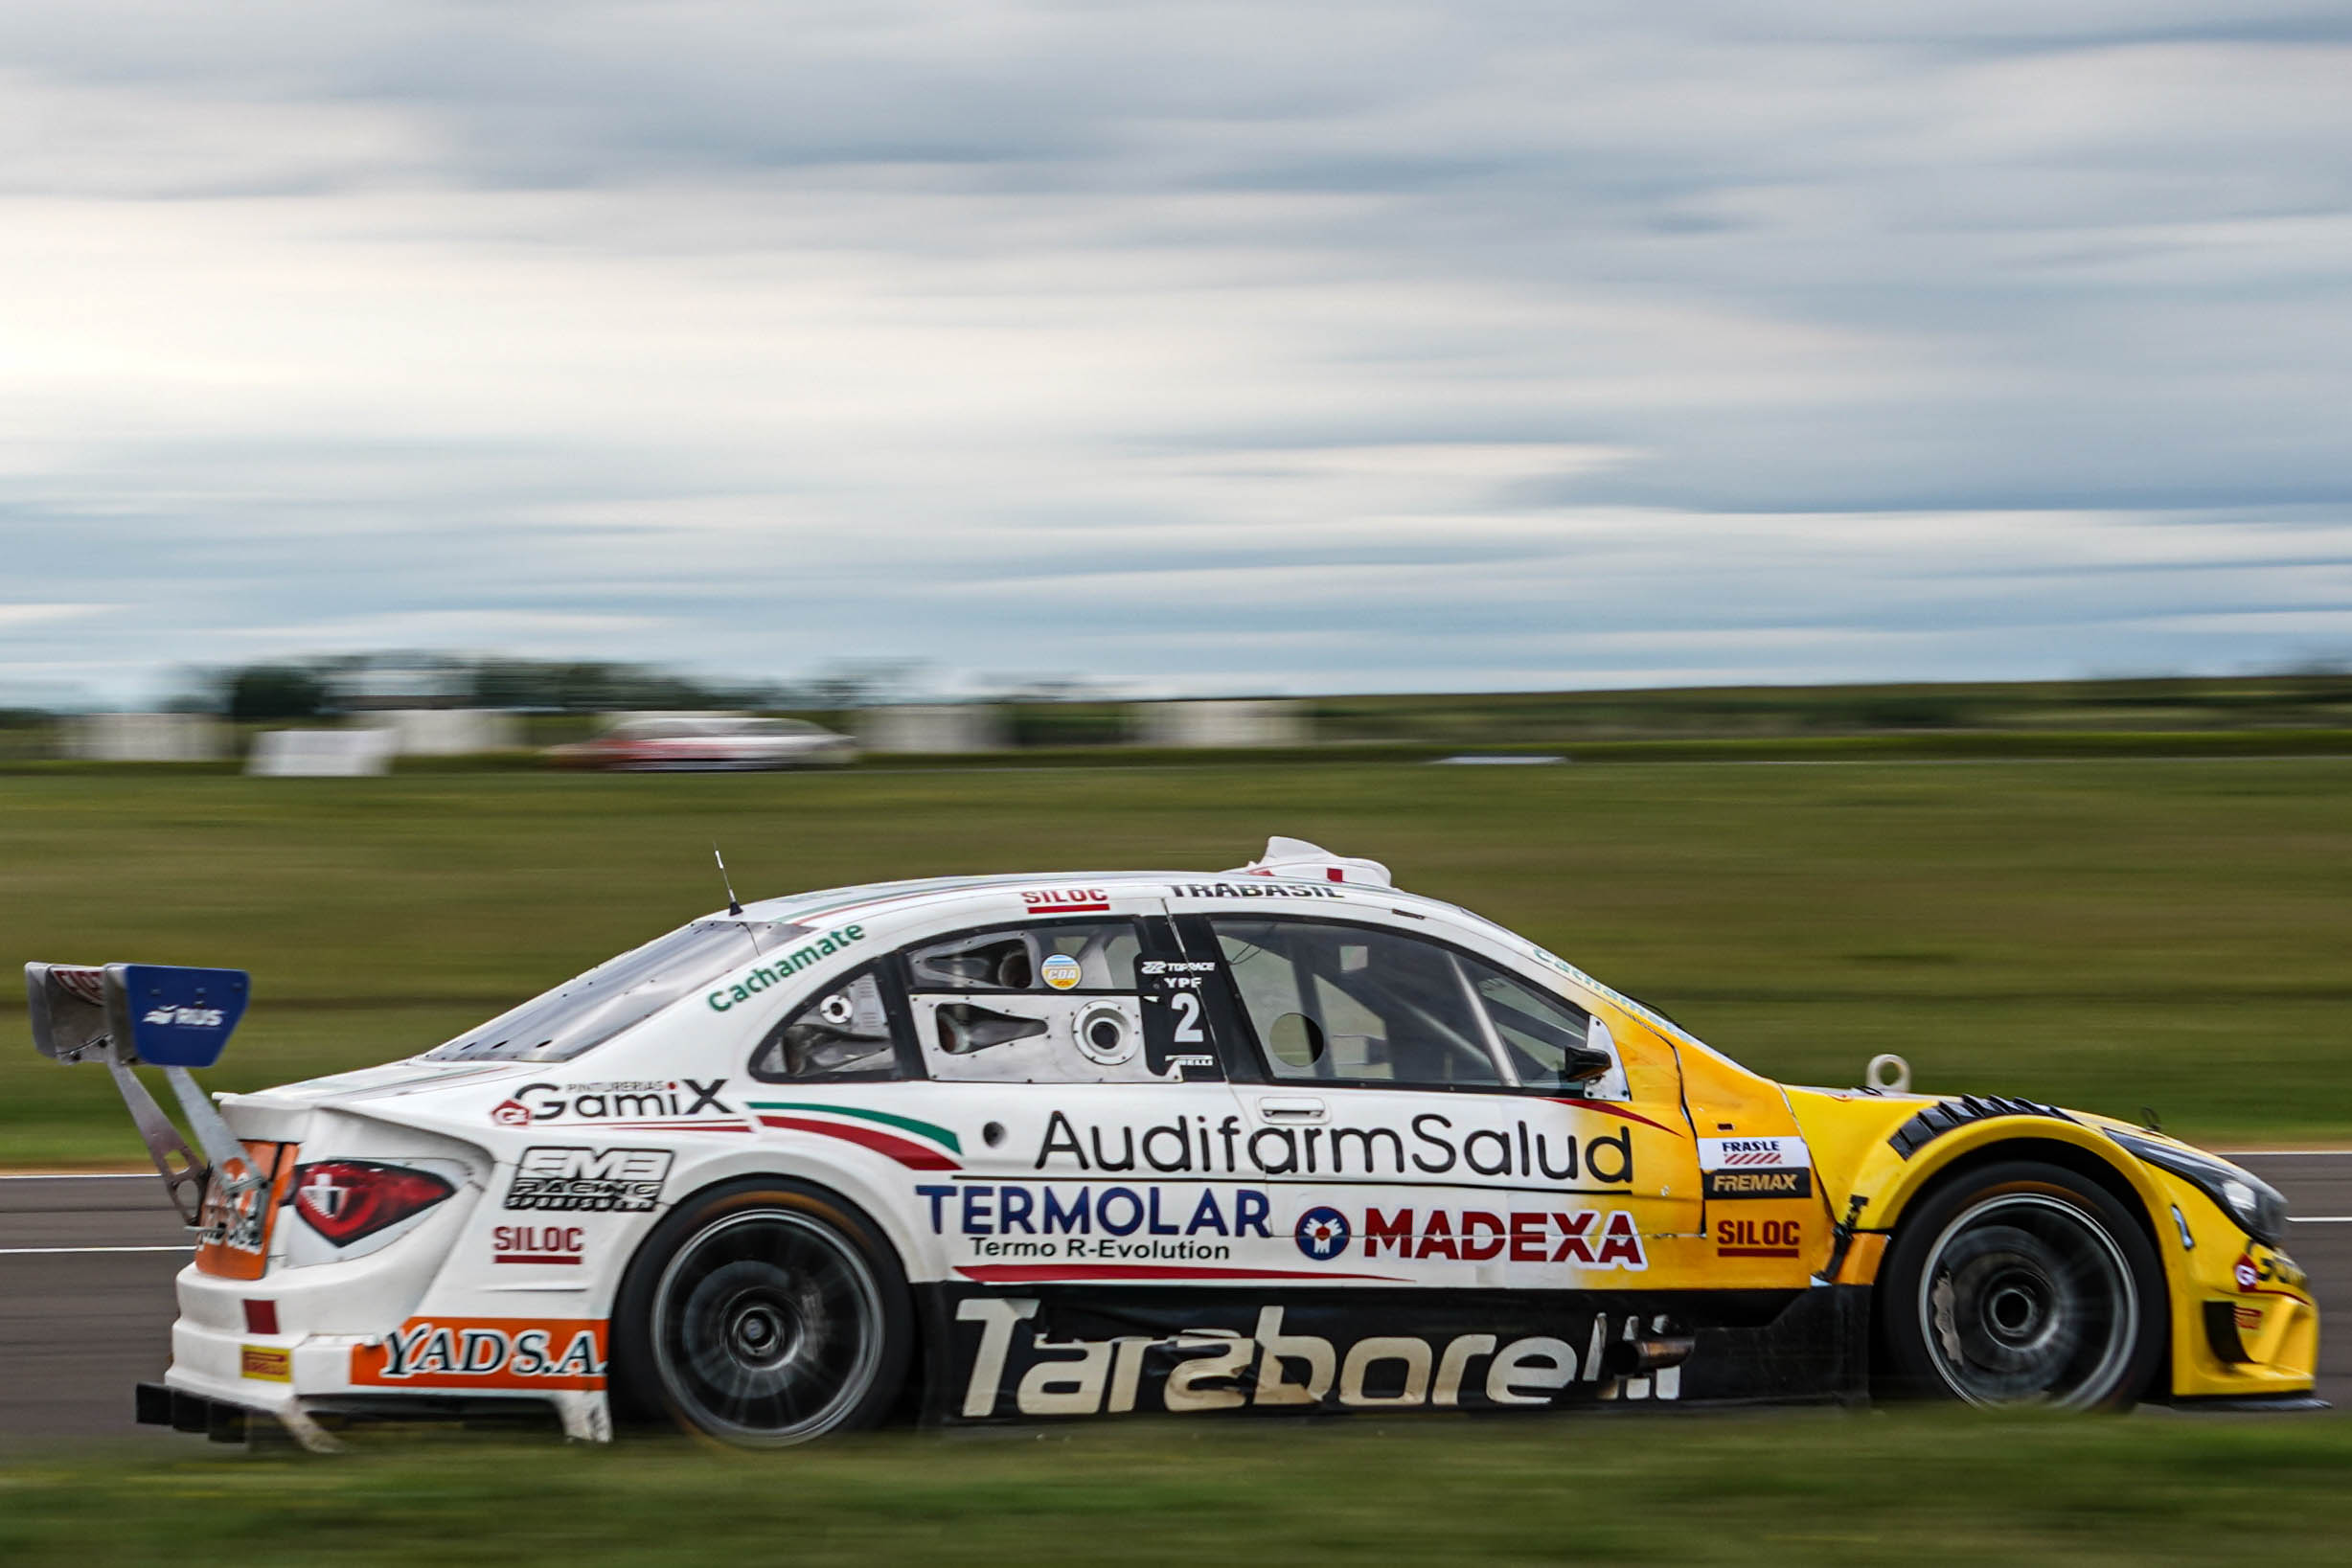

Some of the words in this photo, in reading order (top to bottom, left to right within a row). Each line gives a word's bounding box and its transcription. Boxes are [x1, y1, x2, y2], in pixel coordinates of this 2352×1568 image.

[1022, 889, 1107, 904] SILOC
[1165, 883, 1344, 898] TRABASIL
[709, 923, 866, 1012] Cachamate
[1164, 977, 1202, 989] YPF
[1171, 992, 1204, 1042] 2
[1034, 1109, 1633, 1184] AudifarmSalud
[1712, 1173, 1798, 1193] FREMAX
[915, 1185, 1272, 1238] TERMOLAR
[493, 1226, 583, 1252] SILOC
[1363, 1207, 1643, 1264] MADEXA
[1717, 1219, 1800, 1246] SILOC
[970, 1237, 1057, 1257] Termo
[1067, 1238, 1231, 1261] R-Evolution
